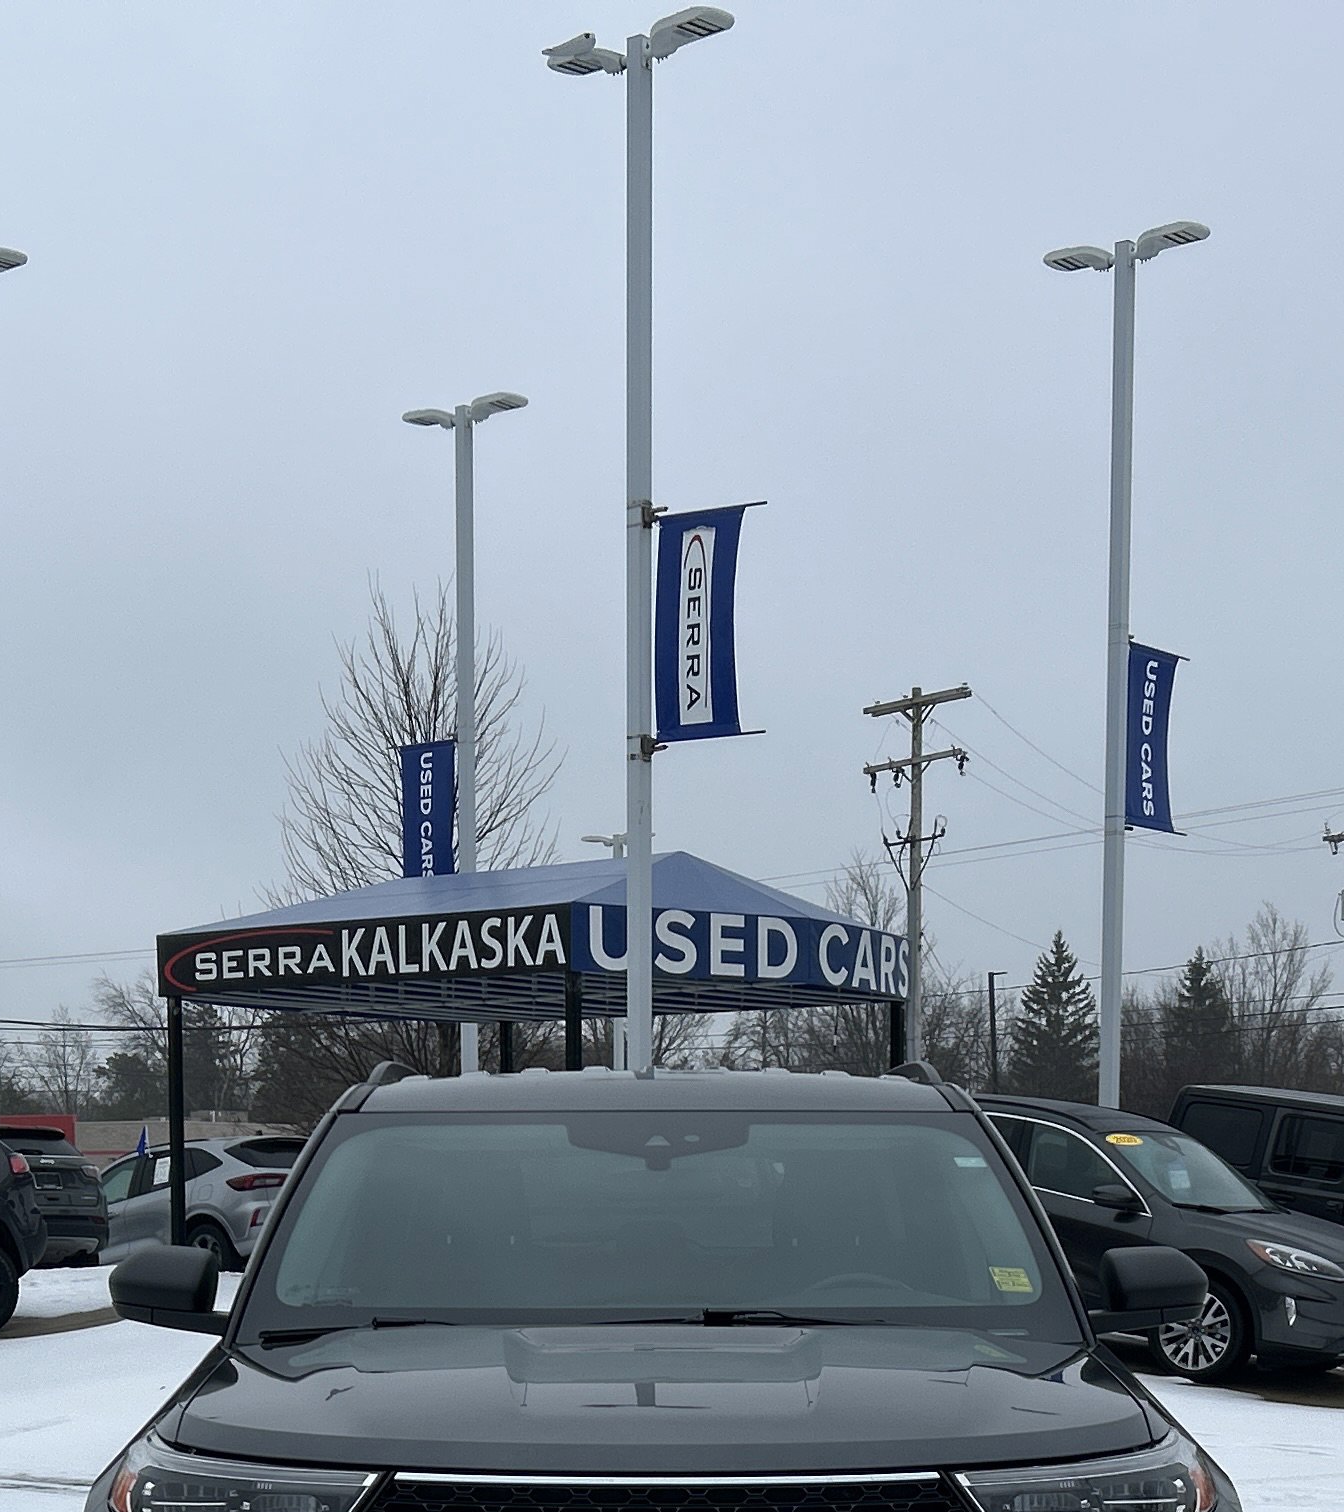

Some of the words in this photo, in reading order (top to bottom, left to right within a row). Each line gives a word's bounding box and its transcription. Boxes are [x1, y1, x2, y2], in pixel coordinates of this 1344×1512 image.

[685, 567, 703, 711] SERRA
[1141, 659, 1159, 736] USED
[419, 751, 434, 815] USED
[1140, 742, 1155, 817] CARS
[193, 942, 336, 982] SERRA
[340, 912, 567, 978] KALKASKA
[588, 904, 799, 980] USED
[818, 922, 910, 999] CARS
